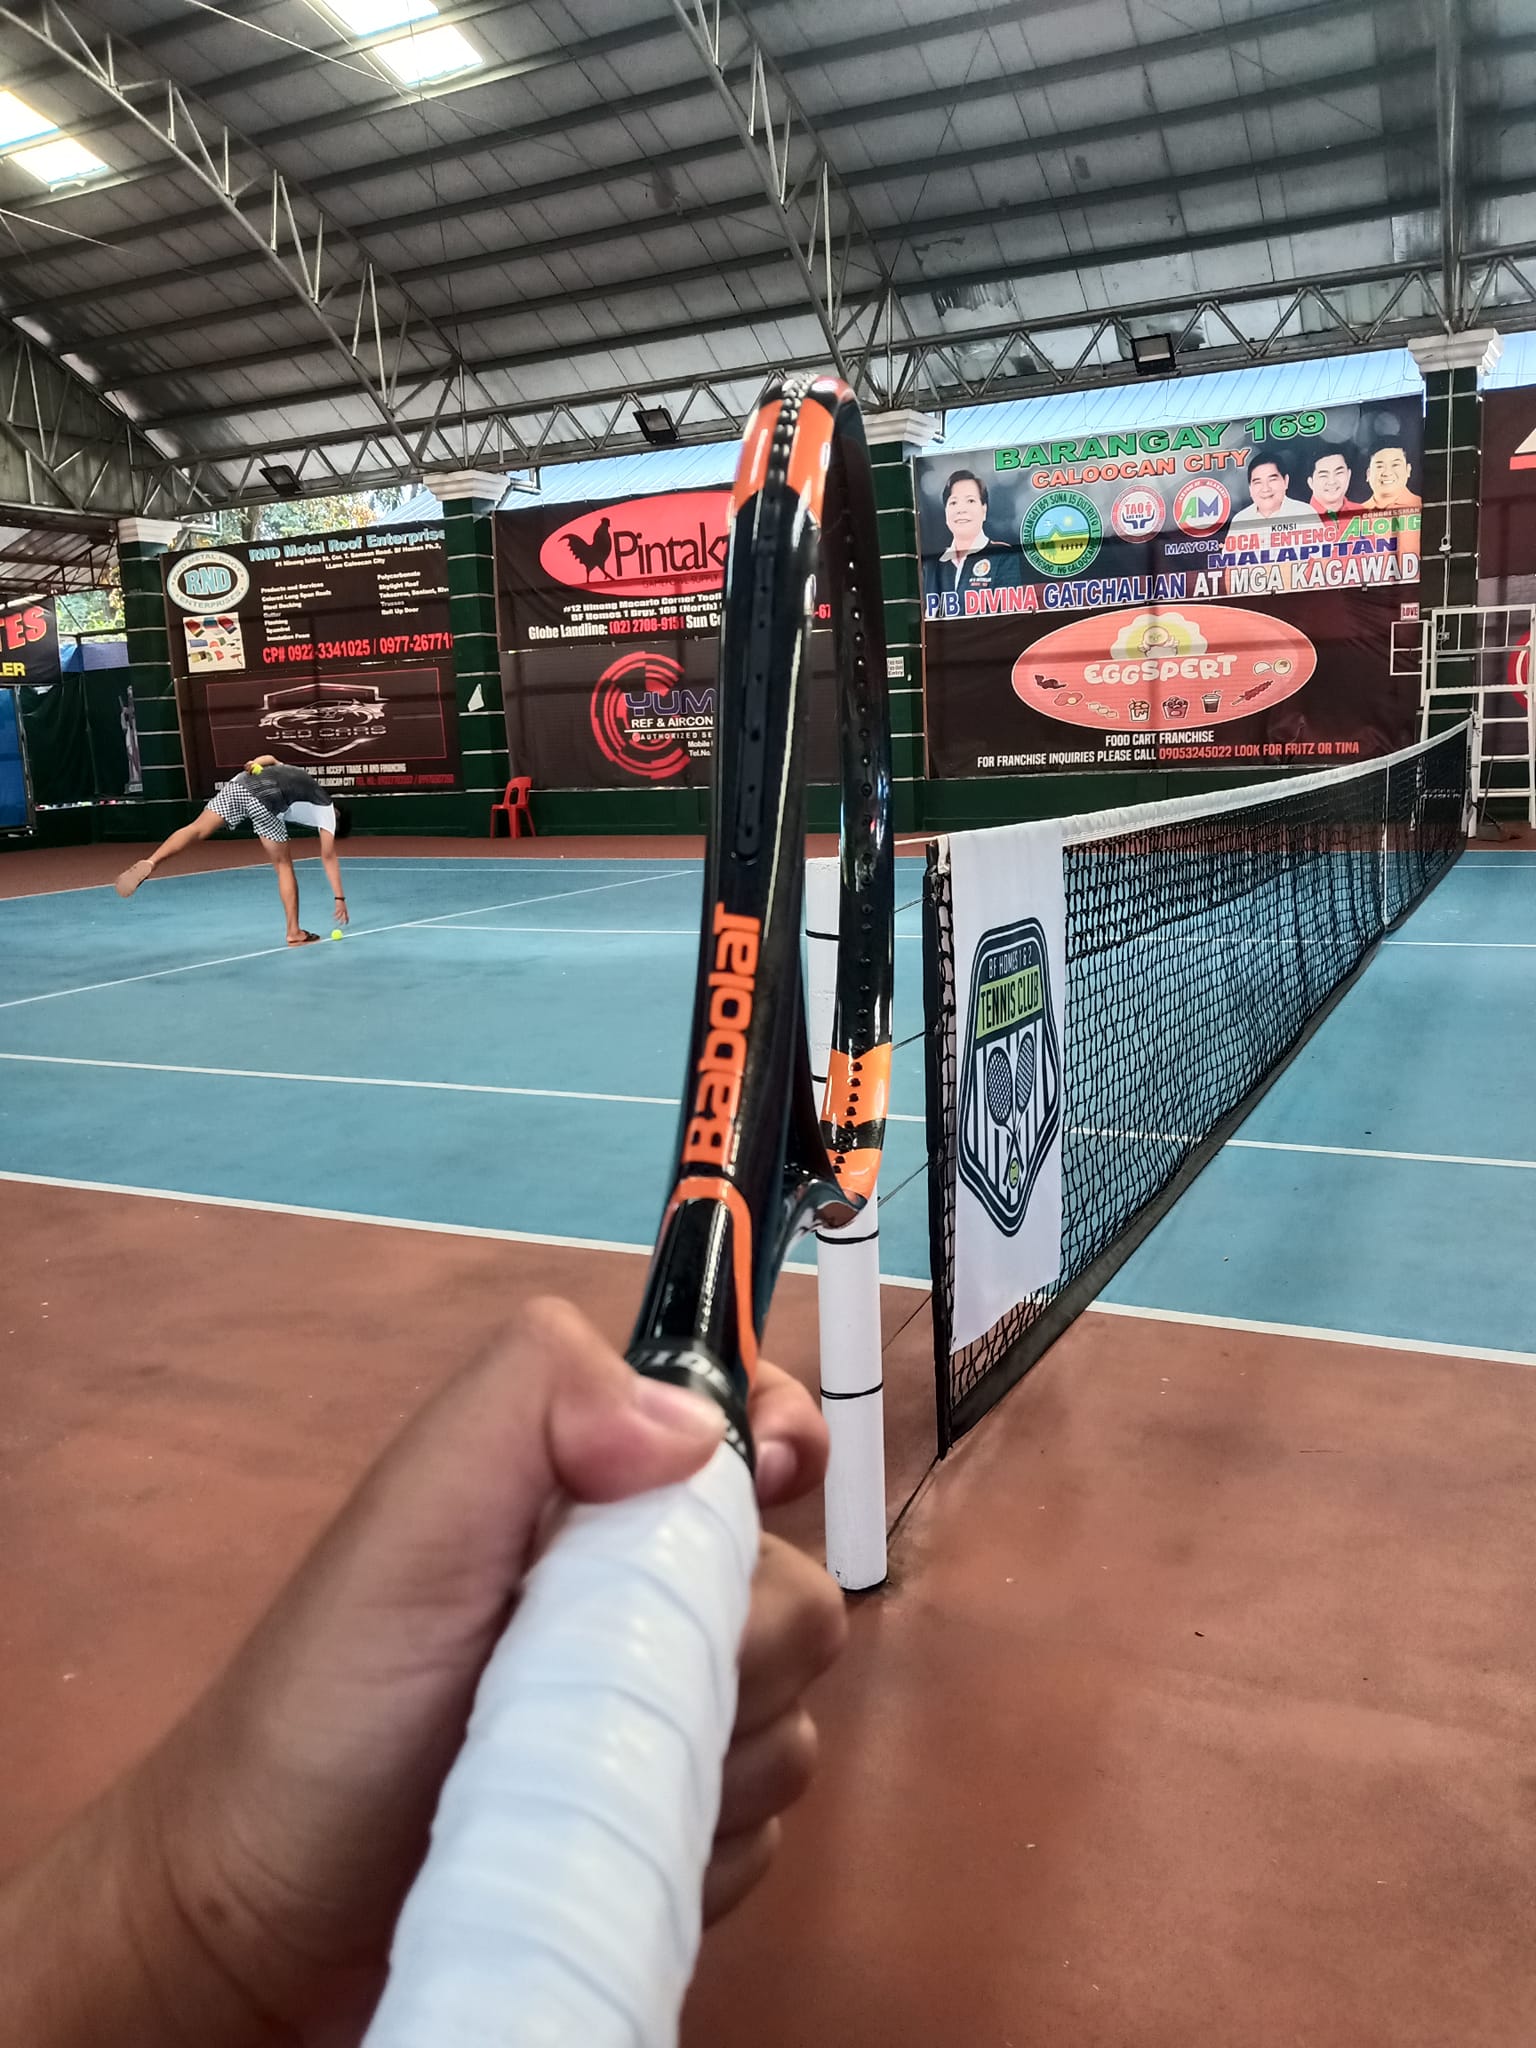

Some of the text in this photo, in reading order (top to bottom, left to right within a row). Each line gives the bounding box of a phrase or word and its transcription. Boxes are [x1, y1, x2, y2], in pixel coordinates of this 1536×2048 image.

[994, 410, 1326, 471] BARANGAY 169
[1031, 449, 1250, 489] CALOOCAN CITY
[1050, 493, 1067, 504] SONA
[1077, 497, 1099, 526] DISTRITO
[1125, 502, 1144, 515] TAO
[1180, 495, 1219, 523] AM
[1362, 507, 1420, 519] CONGRESSMAN
[1165, 526, 1337, 555] MAYOR OCA ENTENG
[1271, 523, 1297, 533] KONSI
[1340, 514, 1421, 542] ALONG
[188, 553, 217, 564] METAL
[248, 547, 281, 562] RND
[283, 540, 325, 558] Metal
[327, 535, 362, 553] Roof
[613, 522, 730, 577] Pintak
[1207, 537, 1397, 569] MALAPITAN
[184, 566, 231, 595] RND
[690, 573, 719, 584] SUPPLY
[926, 552, 1420, 617] P/B DIVINA GATCHALIAN AT MGA KAGAWAD
[179, 591, 241, 609] ENTERPRISES
[563, 604, 582, 613] #12
[661, 595, 696, 605] Corner
[585, 611, 622, 620] Homes
[658, 606, 677, 614] 169
[680, 602, 717, 613] (North)
[1402, 606, 1418, 617] LOVE
[528, 625, 559, 640] Globe
[560, 622, 608, 638] Landline:
[609, 620, 630, 635] (02)
[685, 614, 708, 629] Sun
[263, 646, 286, 664] CP#
[287, 639, 370, 662] 0922-3341025
[1083, 654, 1238, 685] EGGSPERT
[631, 716, 713, 728] REF & AIRCON
[640, 732, 698, 740] AUTHORIZED
[687, 740, 710, 748] Mobile
[1105, 730, 1215, 747] FOOD CART FRANCHISE
[977, 741, 1359, 768] FOR FRANCHISE INQUIRIES PLEASE CALL 09053245022 LOOK FOR FRITZ OR TINA
[326, 765, 345, 774] ACCEPT
[343, 777, 355, 786] CITY
[988, 956, 997, 979] BF
[999, 949, 1018, 976] HOMES
[1028, 944, 1032, 965] 2
[981, 970, 1039, 1031] TENNIS CLUB
[681, 902, 761, 1172] Babolat
